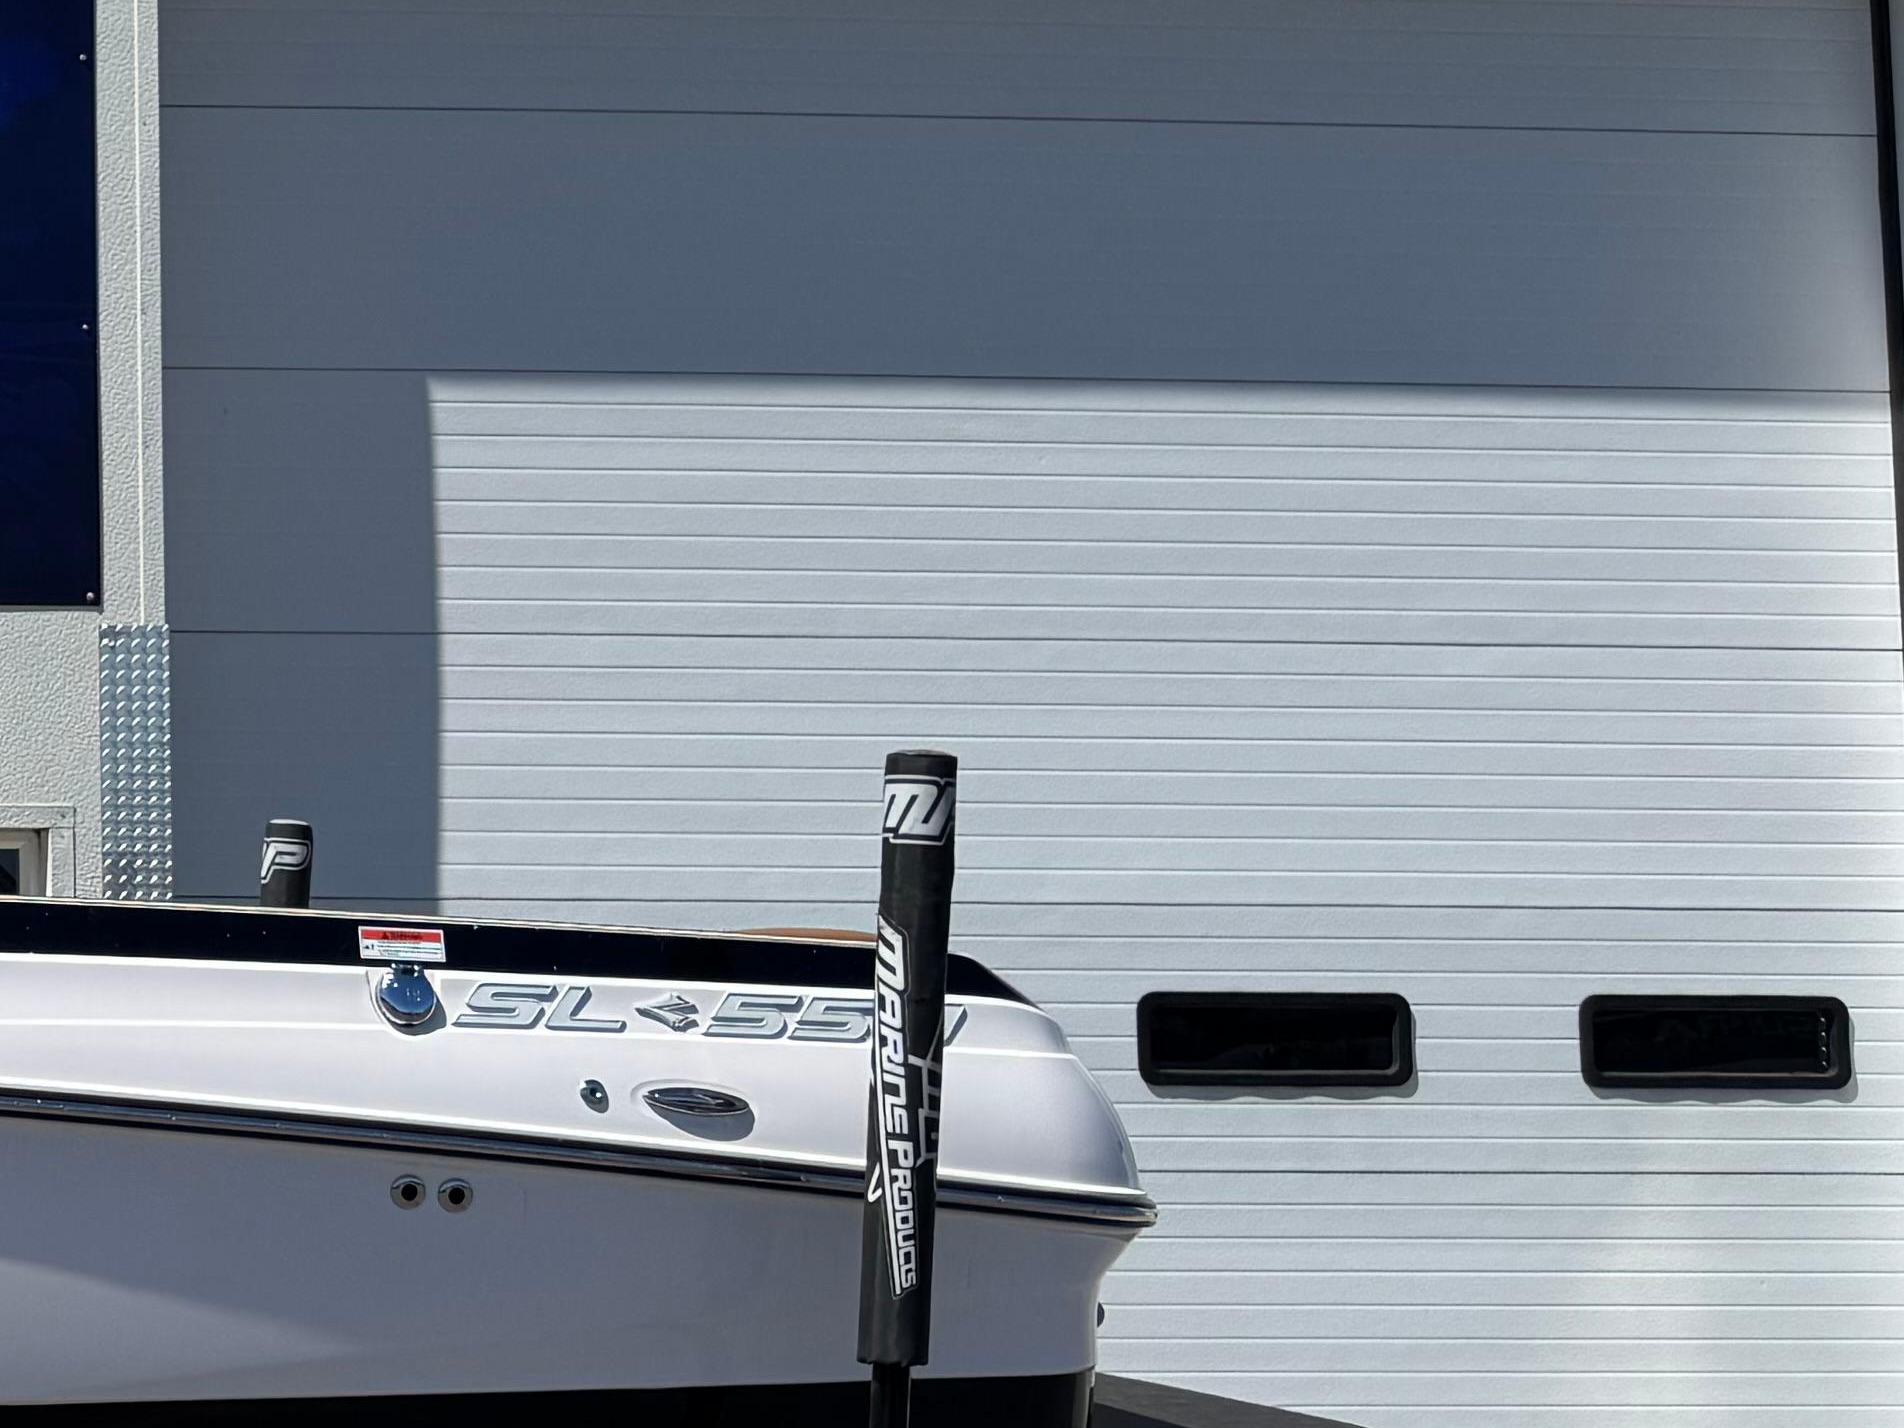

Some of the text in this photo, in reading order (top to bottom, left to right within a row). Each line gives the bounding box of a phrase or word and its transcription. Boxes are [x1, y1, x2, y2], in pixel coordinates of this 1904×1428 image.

[451, 983, 626, 1033] SL
[875, 915, 910, 1137] MARINE
[888, 1139, 917, 1290] PRODUCTS
